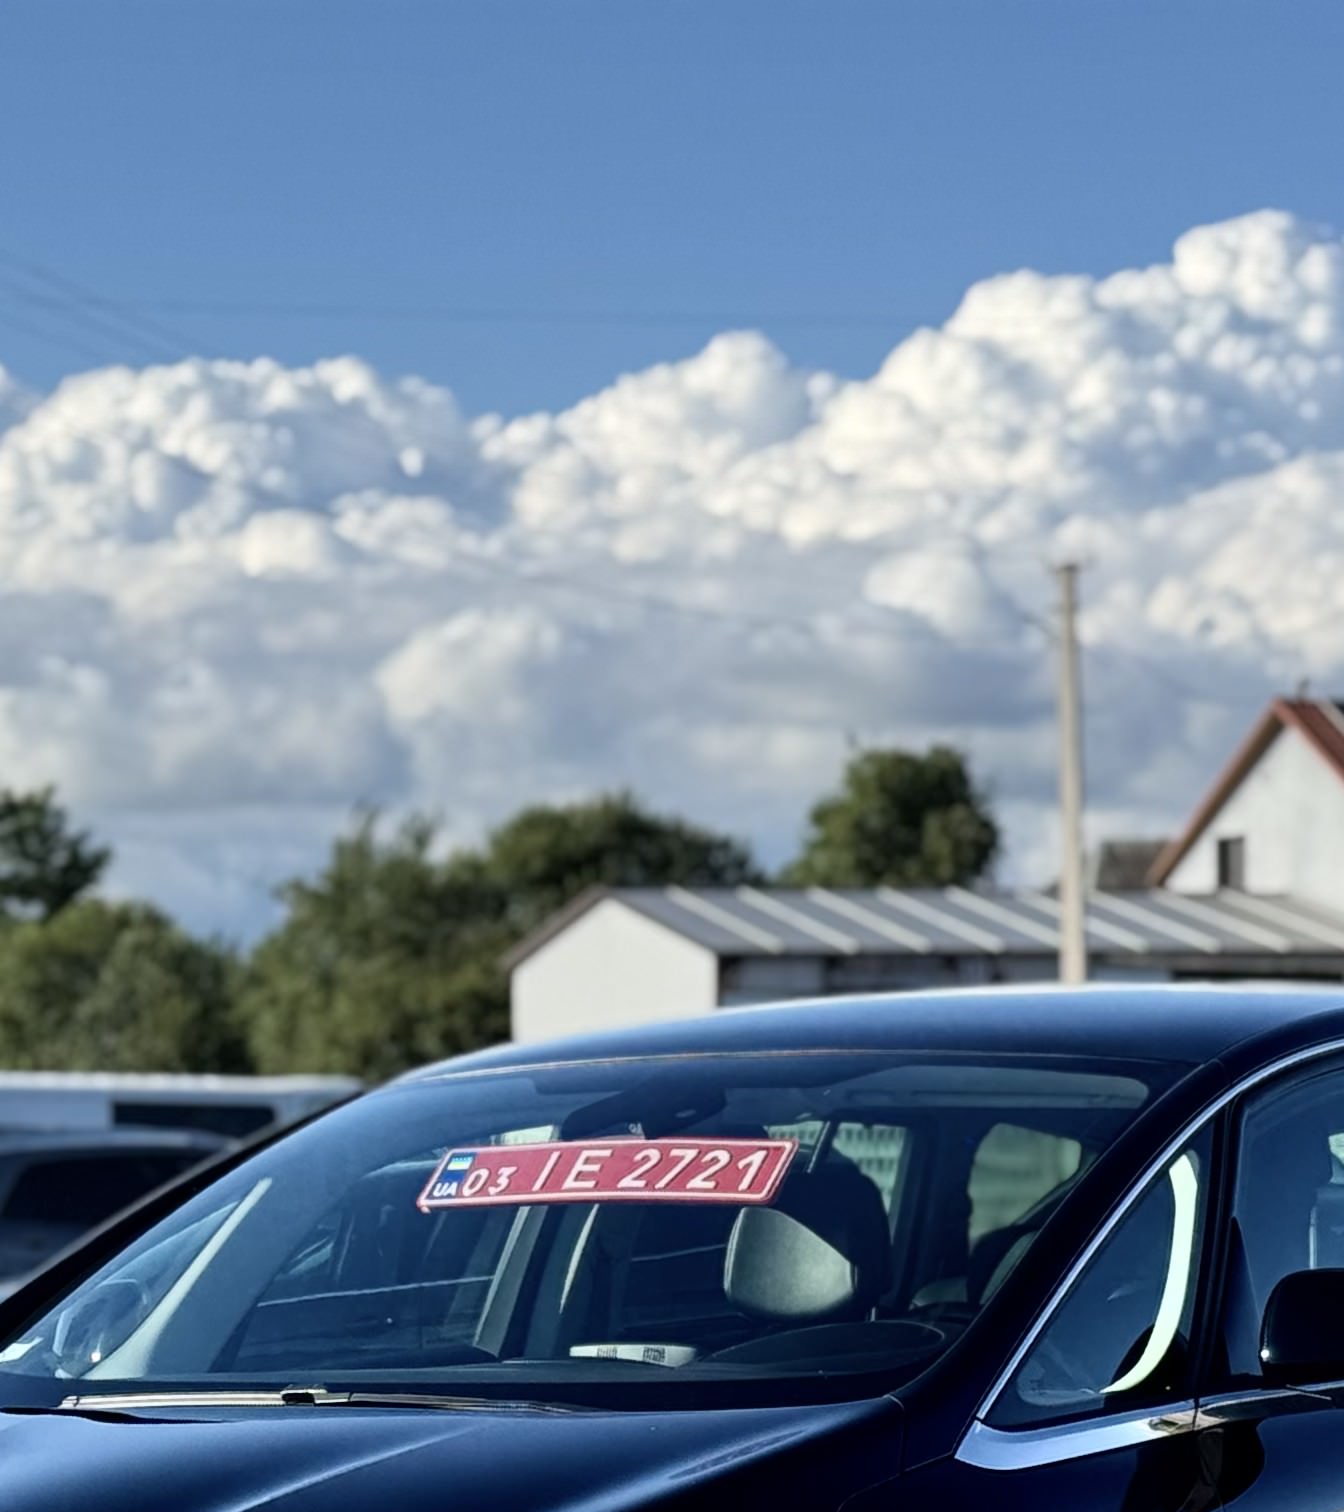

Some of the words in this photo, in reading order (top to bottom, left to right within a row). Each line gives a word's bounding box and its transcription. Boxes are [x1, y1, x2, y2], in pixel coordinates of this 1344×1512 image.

[431, 1181, 458, 1198] UA
[461, 1165, 518, 1198] 03
[617, 1147, 768, 1192] 2721
